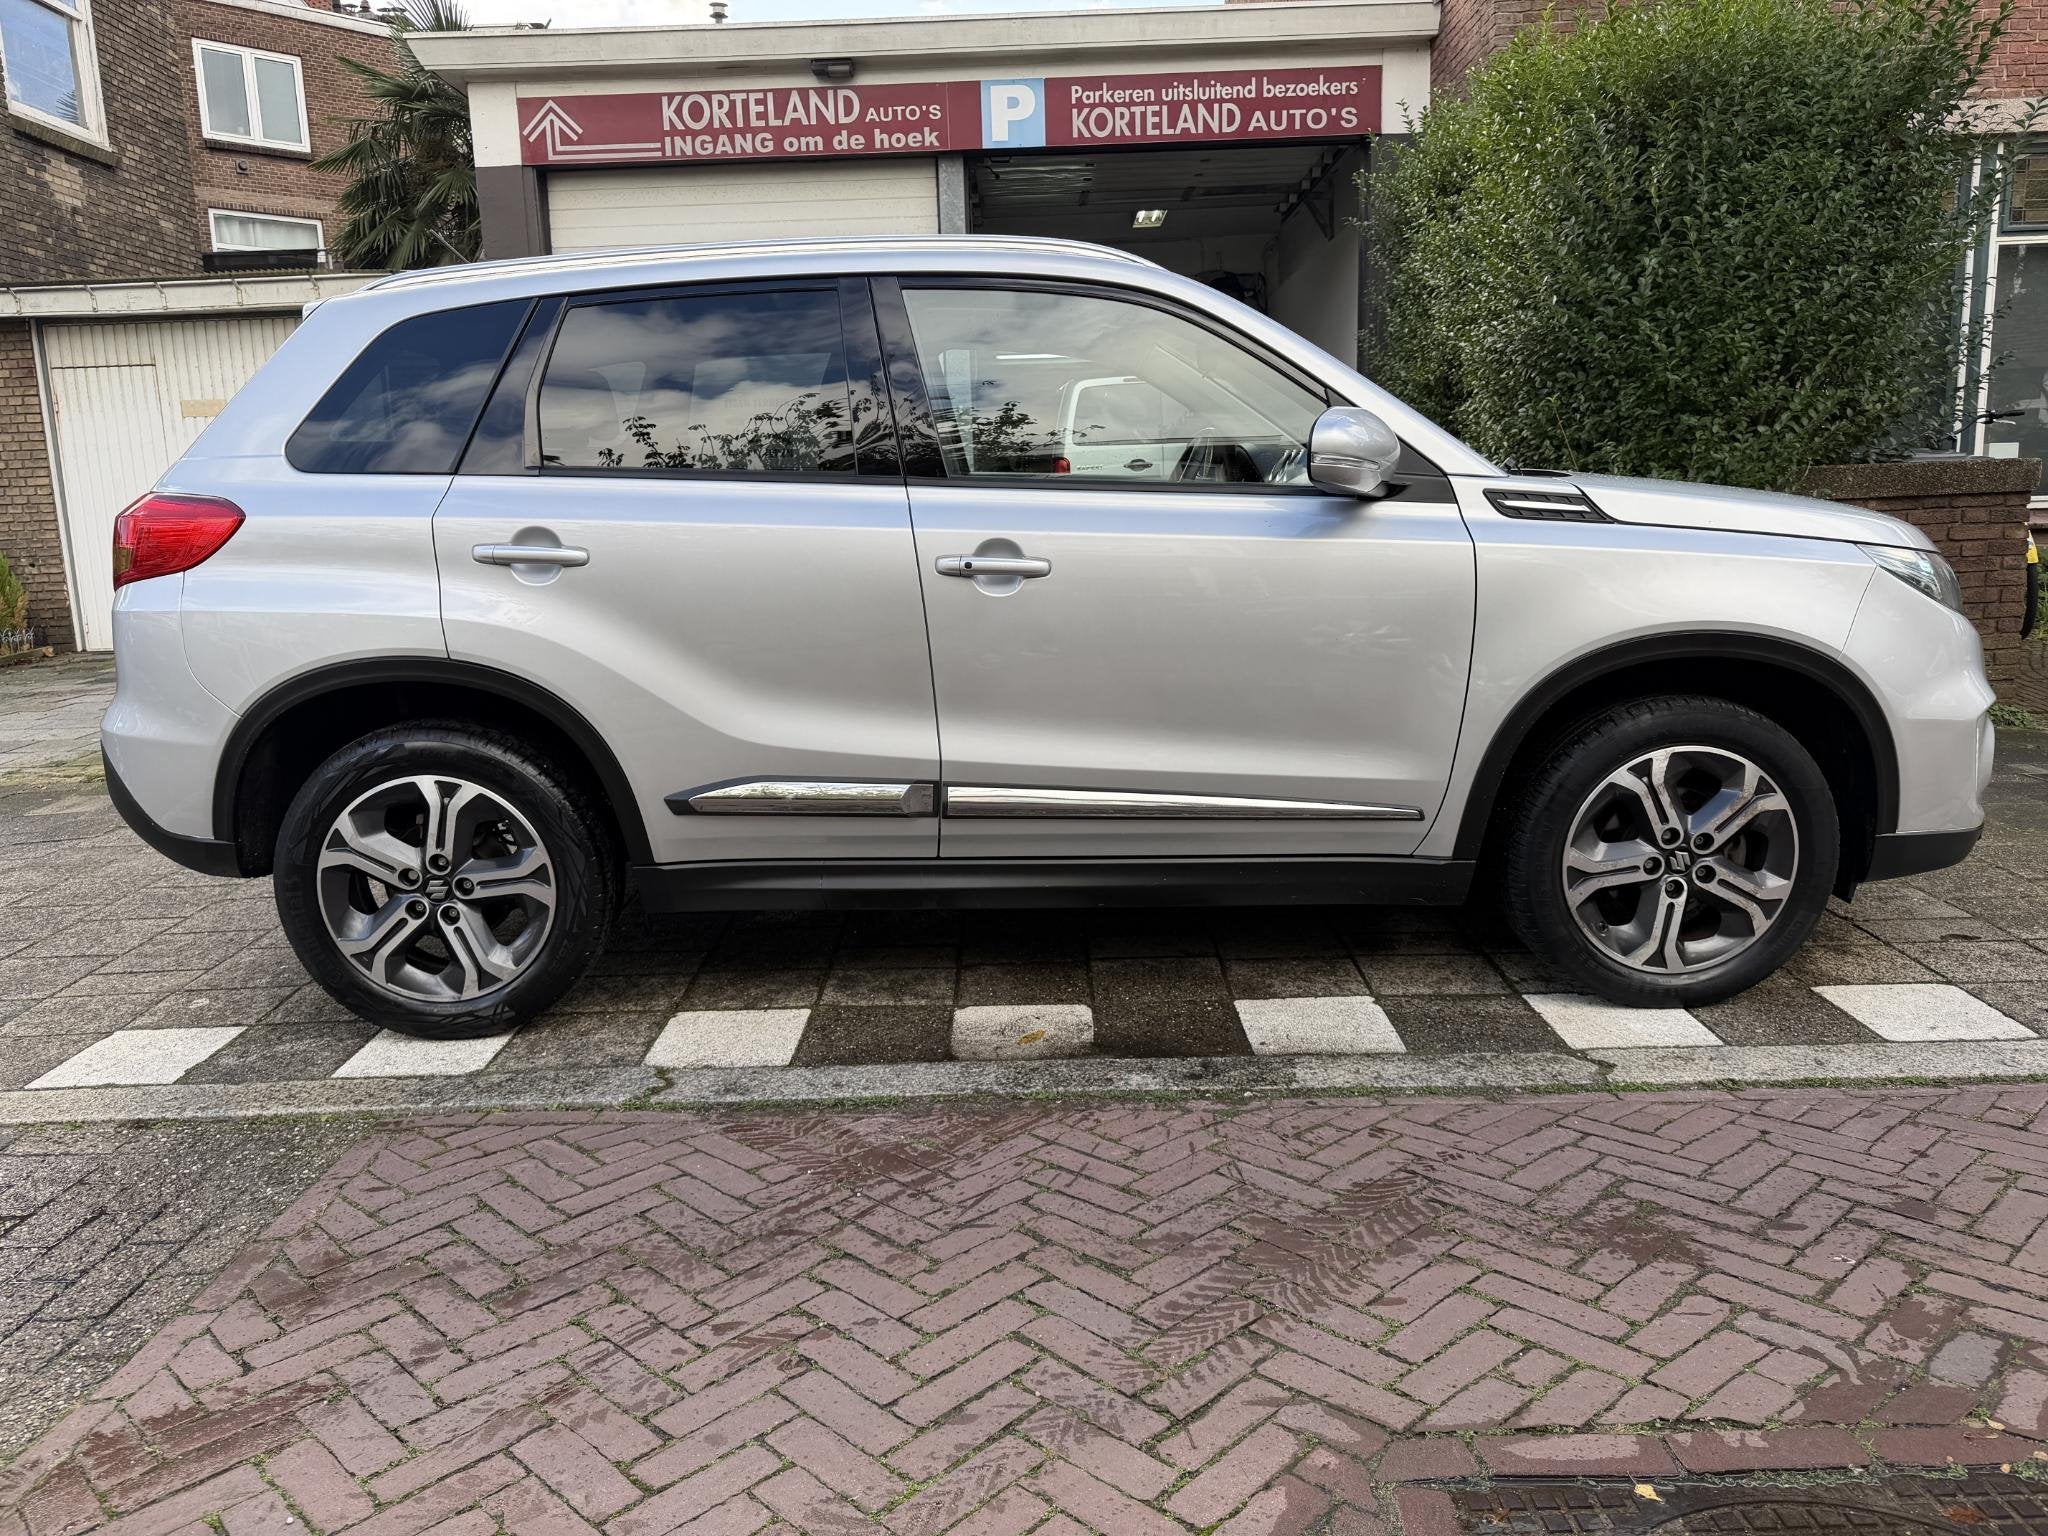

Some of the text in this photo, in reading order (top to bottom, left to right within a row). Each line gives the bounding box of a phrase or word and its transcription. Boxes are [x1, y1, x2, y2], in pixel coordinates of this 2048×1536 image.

[1070, 74, 1358, 104] Parkeren uitsluitend bezoekers
[661, 88, 942, 131] KORTELAND AUTO'S
[990, 84, 1036, 142] P
[1071, 102, 1358, 138] KORTELAND AUTO'S
[664, 126, 940, 157] INGANG om de hoek
